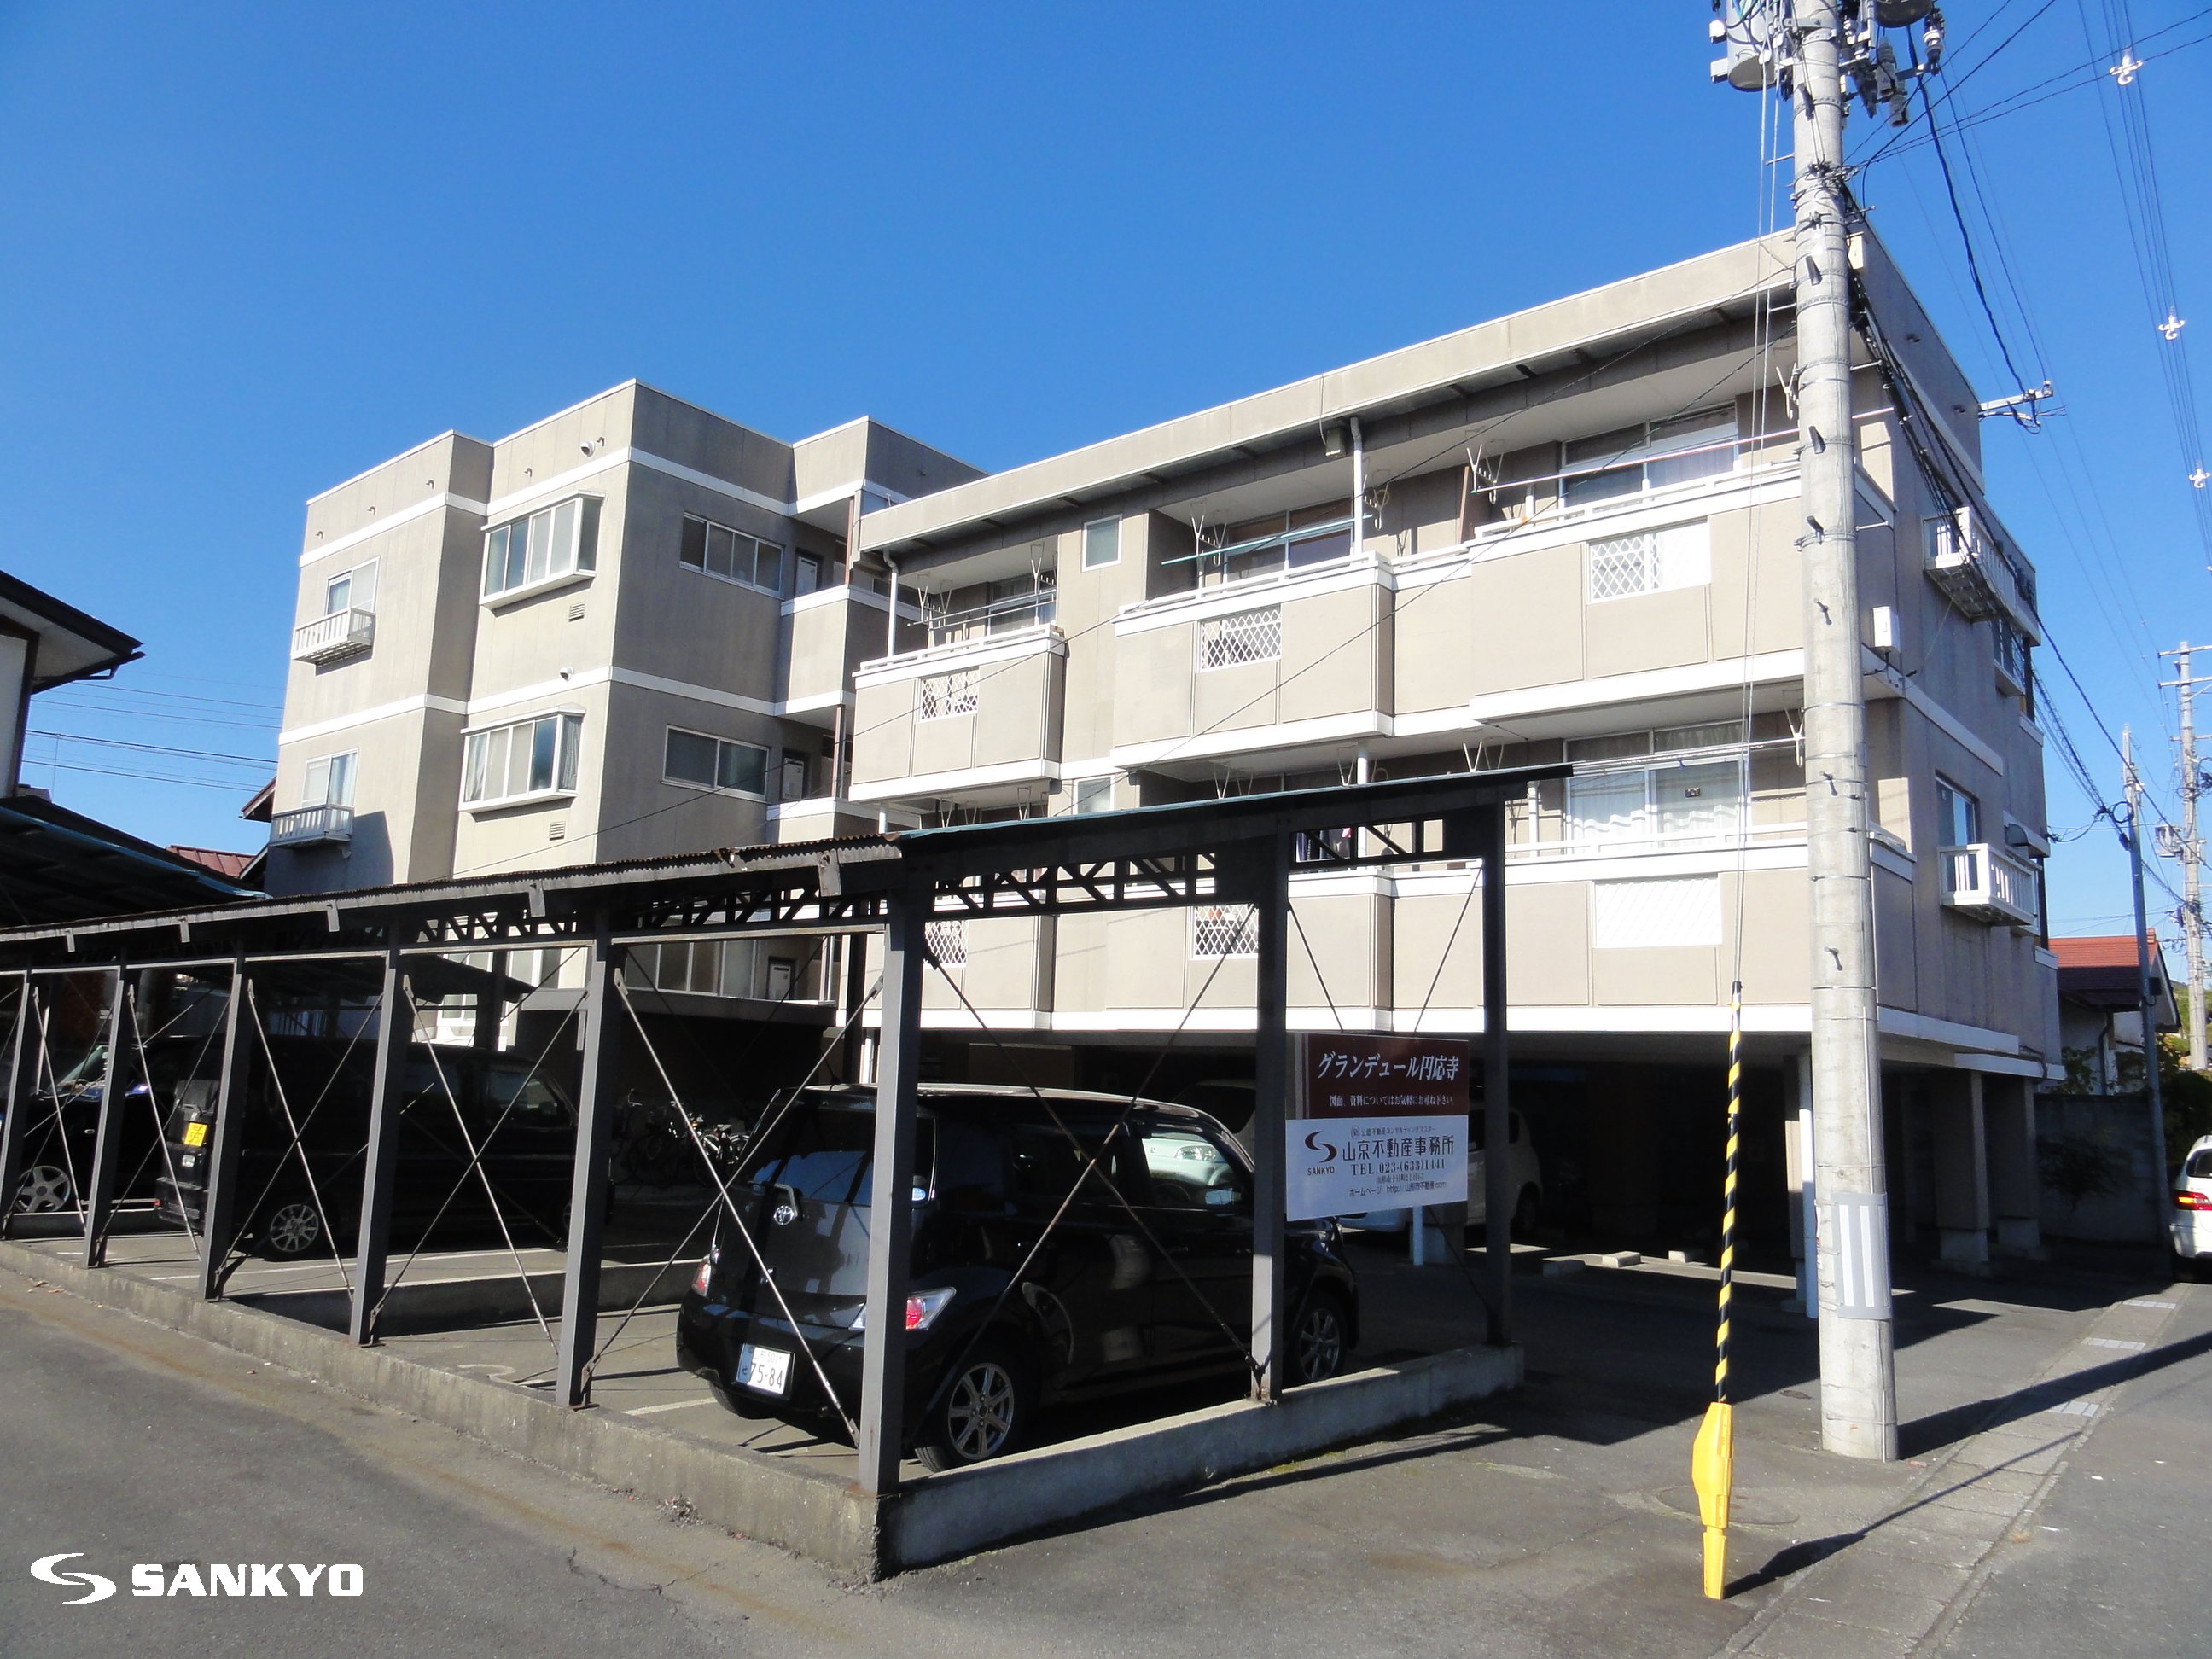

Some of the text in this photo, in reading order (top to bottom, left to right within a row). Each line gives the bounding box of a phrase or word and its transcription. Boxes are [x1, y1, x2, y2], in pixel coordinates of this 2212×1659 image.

[1317, 1051, 1459, 1081] グランデュール円応寺
[1342, 1135, 1454, 1161] 山京不動産事務所
[1307, 1167, 1335, 1176] SANKYO
[1349, 1186, 1382, 1196] ホームページ
